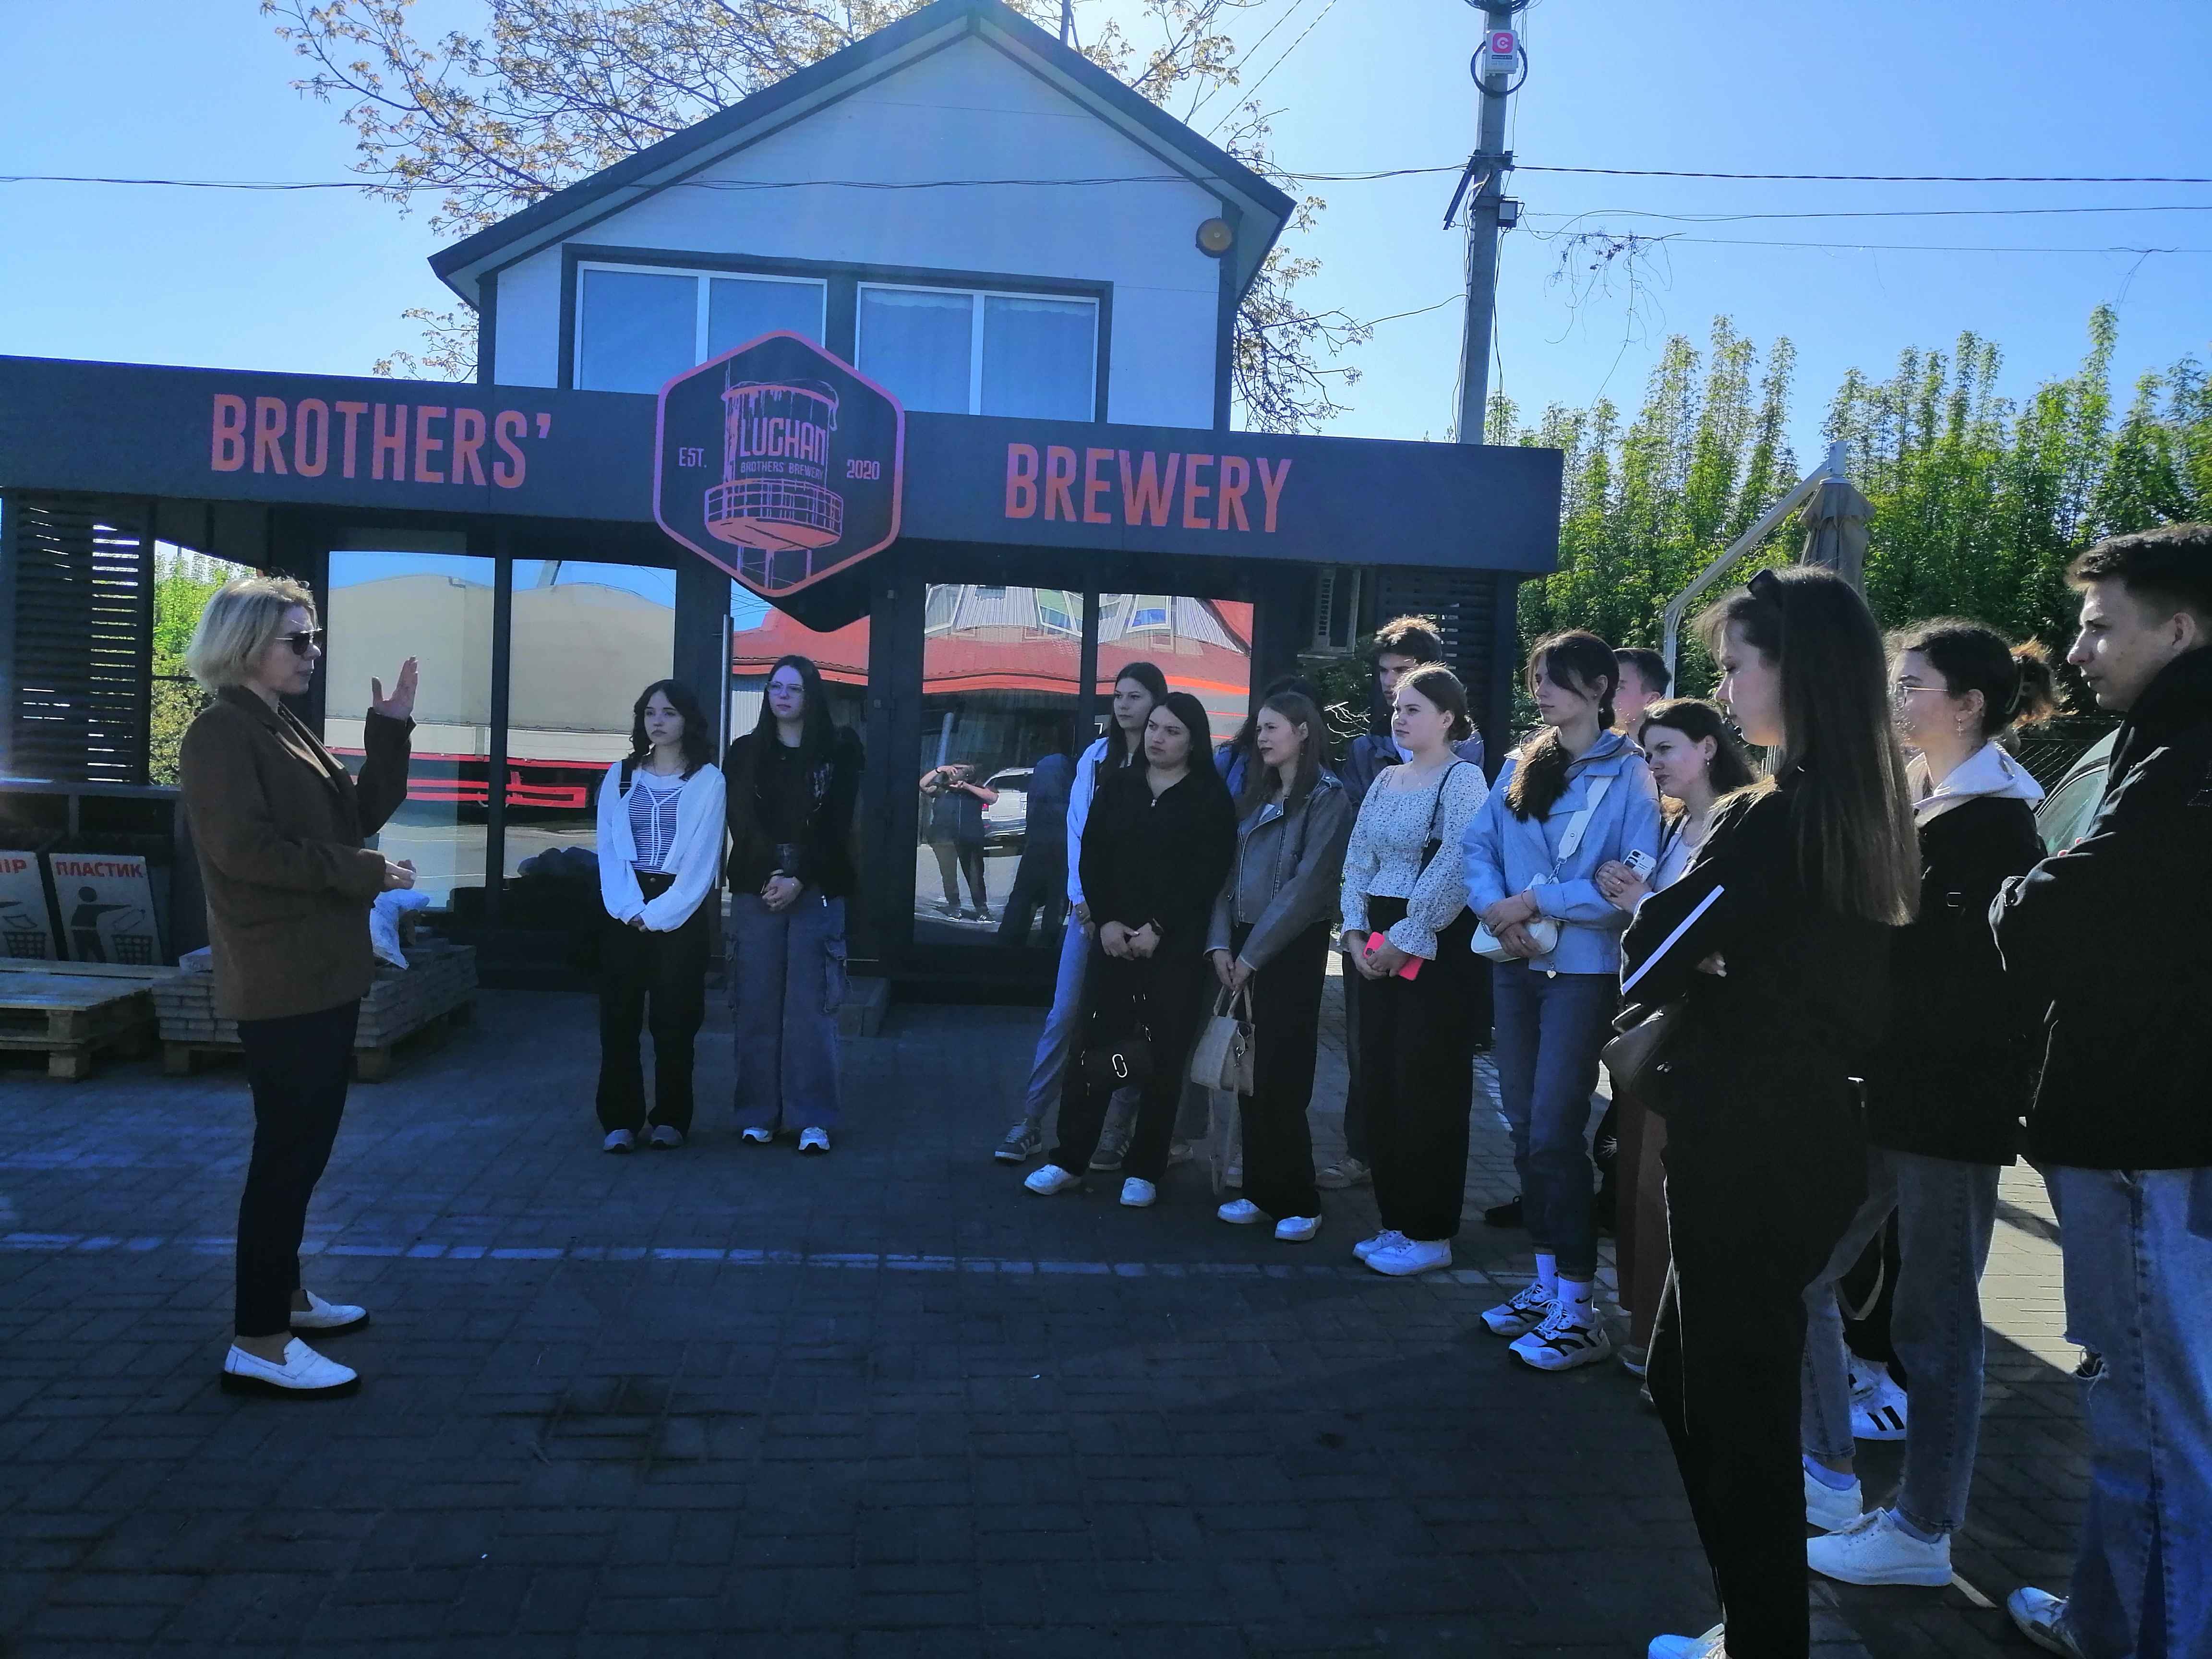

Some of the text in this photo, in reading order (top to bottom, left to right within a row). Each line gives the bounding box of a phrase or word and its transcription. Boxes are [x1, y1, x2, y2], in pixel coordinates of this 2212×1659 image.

[740, 417, 826, 466] LUCHAN
[211, 394, 1292, 533] BROTHERS' BREWERY
[679, 447, 880, 480] EST. 2020
[788, 462, 824, 481] BREWERY
[56, 861, 144, 878] ПЛАСТИК
